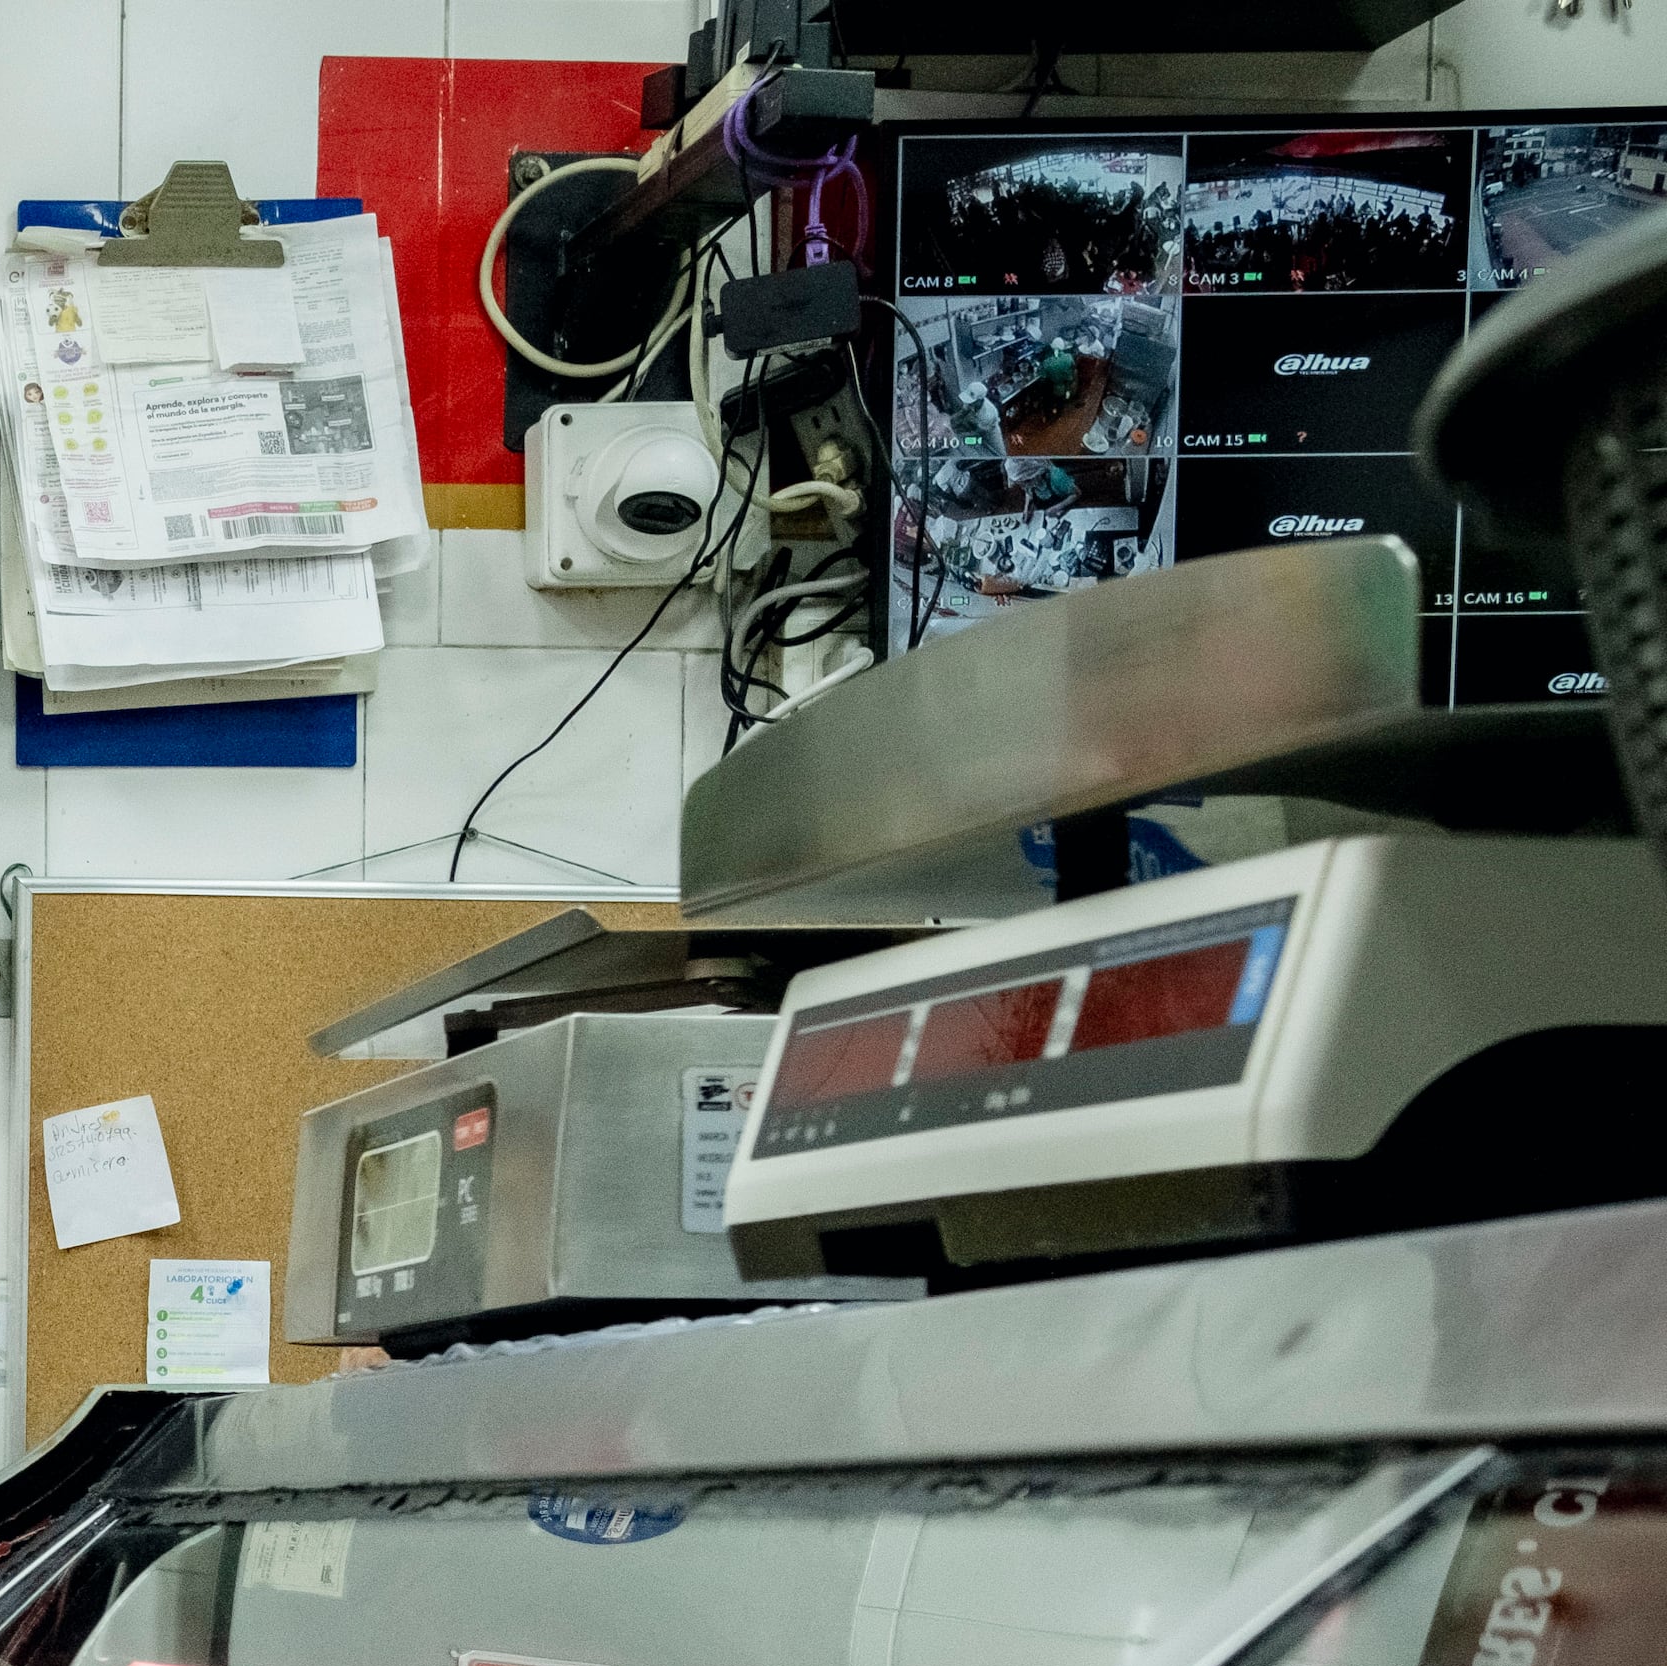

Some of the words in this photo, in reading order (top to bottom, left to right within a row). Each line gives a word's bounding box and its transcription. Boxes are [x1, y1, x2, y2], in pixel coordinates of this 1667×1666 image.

[1188, 273, 1225, 285] CAM
[1229, 273, 1240, 284] 3
[1456, 270, 1467, 282] 3
[1478, 269, 1514, 280] CAM
[903, 276, 939, 288] CAM
[943, 276, 954, 288] 8
[145, 399, 185, 412] Aprende,
[187, 396, 219, 409] explora
[155, 409, 187, 420] mundo
[188, 407, 200, 416] de
[200, 405, 209, 414] la
[941, 435, 960, 449] 10
[1155, 435, 1173, 448] 10
[1183, 435, 1220, 447] CAM
[1224, 435, 1244, 447] 15
[1434, 593, 1453, 606] 13
[1463, 592, 1500, 605] CAM
[1505, 592, 1524, 604] 16
[189, 1285, 205, 1304] 4
